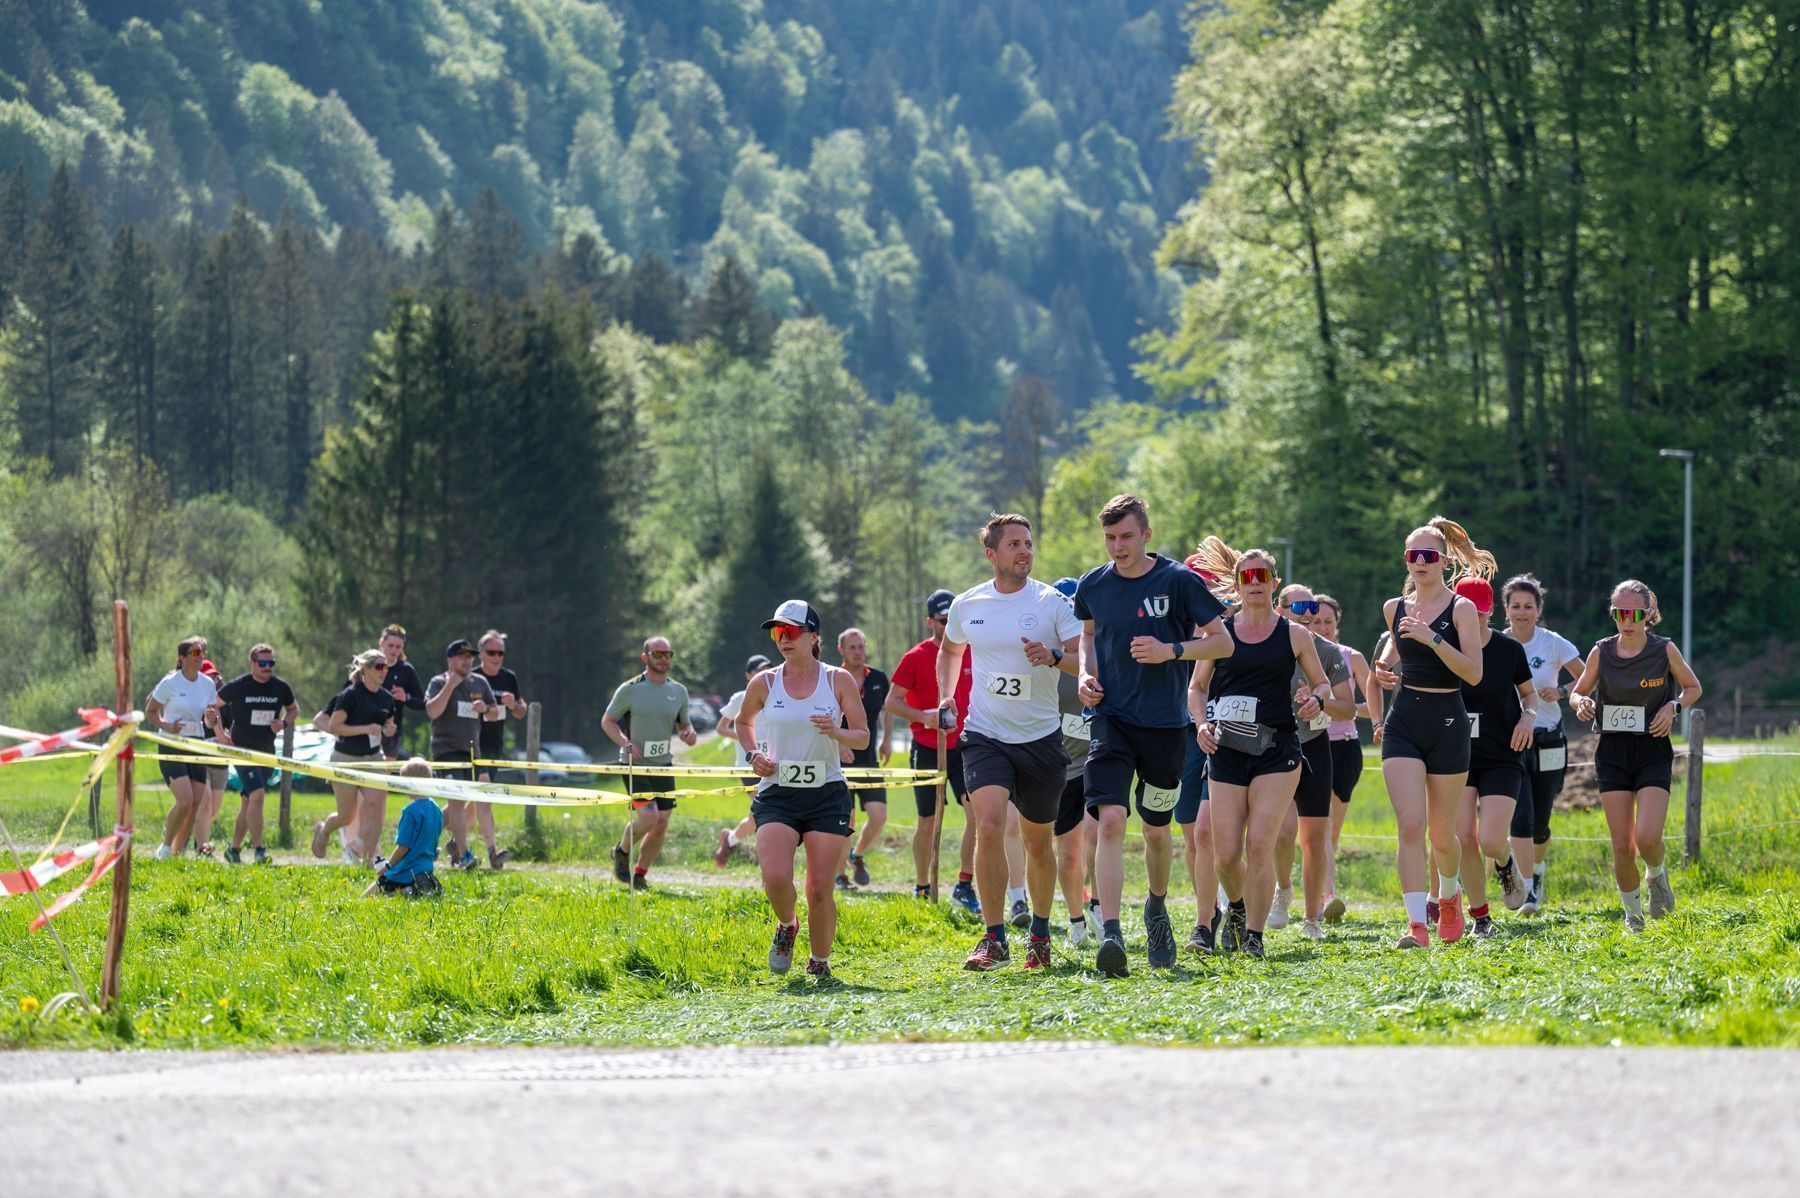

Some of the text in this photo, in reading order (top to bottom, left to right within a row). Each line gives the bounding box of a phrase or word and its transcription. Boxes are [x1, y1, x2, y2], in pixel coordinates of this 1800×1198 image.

[988, 674, 1021, 697] 823
[1219, 699, 1249, 720] 697
[1610, 708, 1636, 728] 643
[1067, 718, 1091, 735] 615
[650, 743, 664, 755] 86
[780, 764, 816, 784] 825
